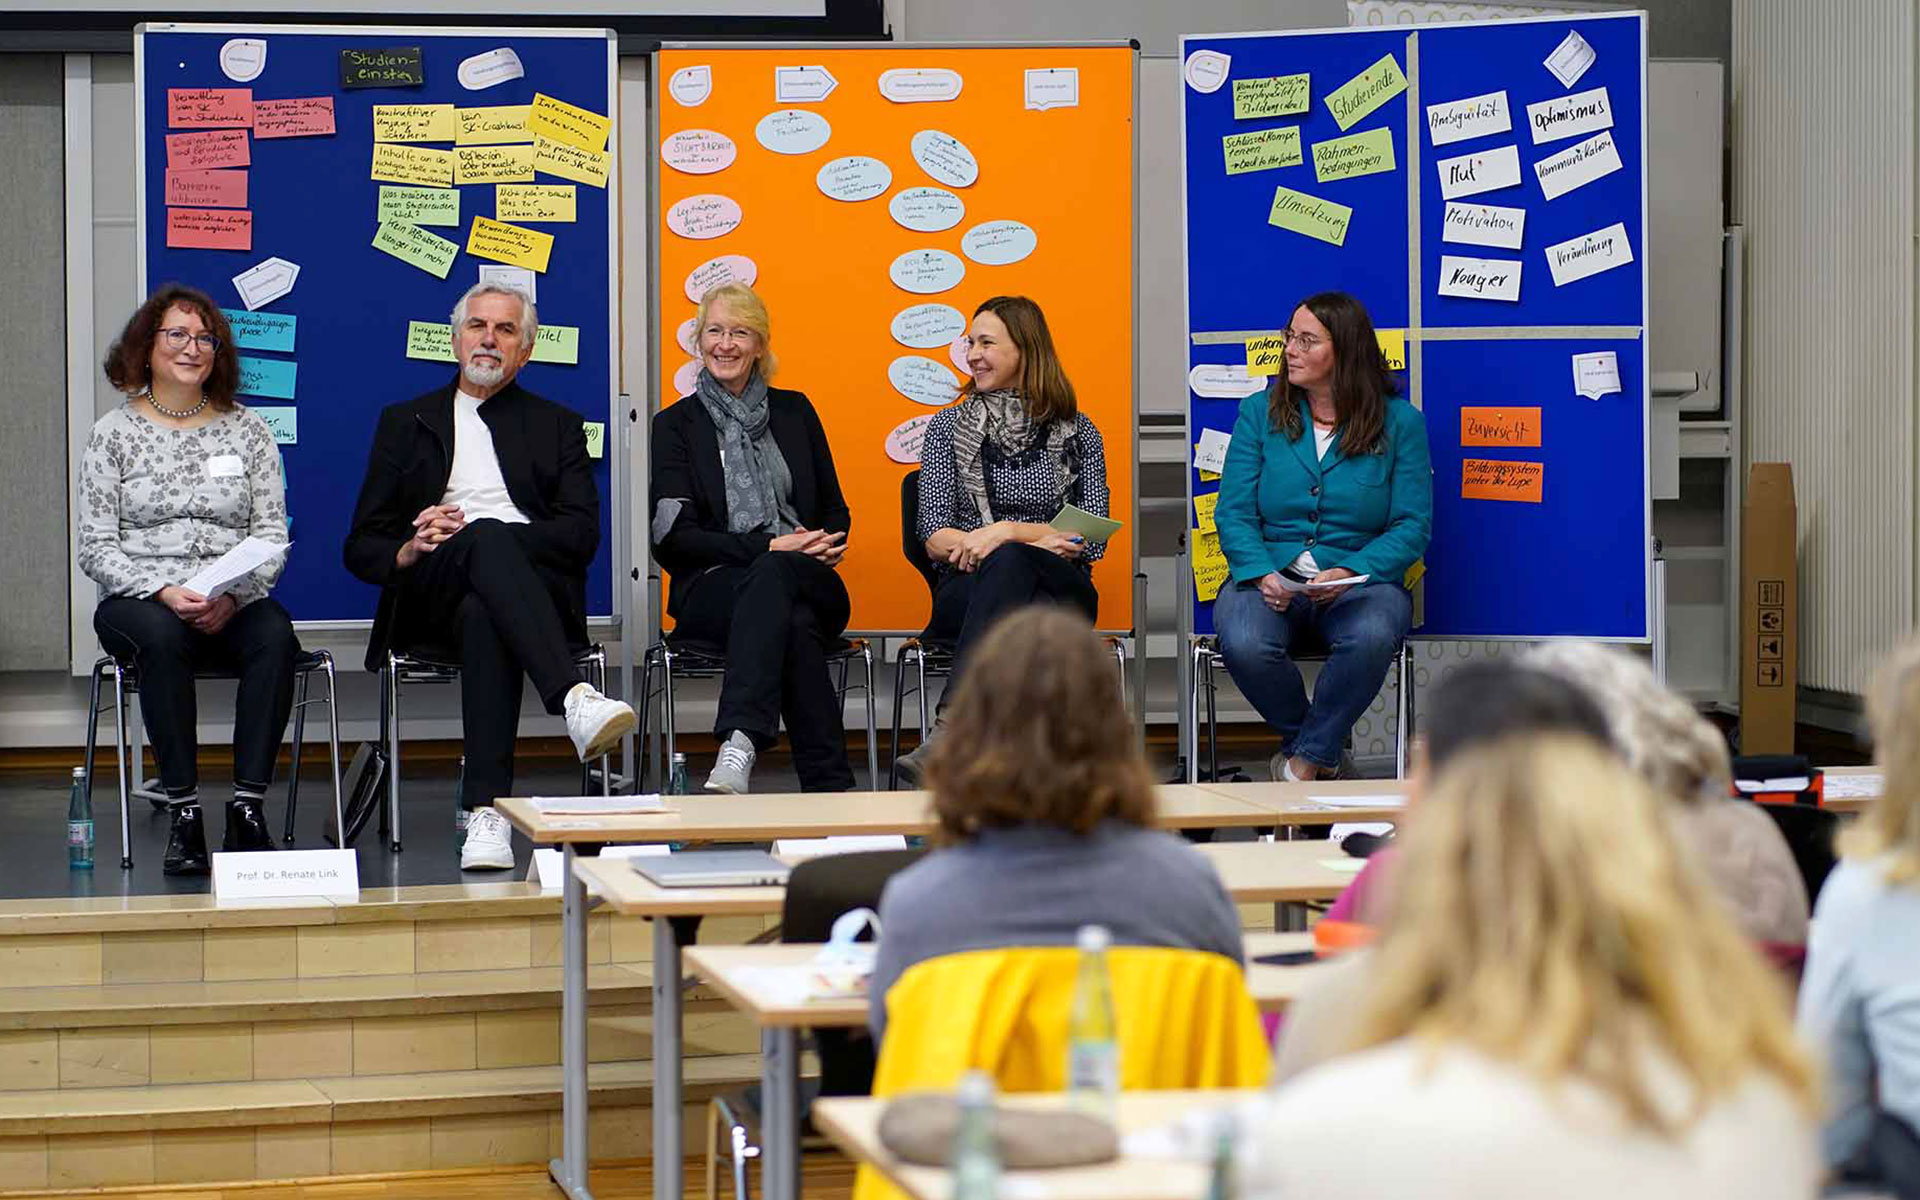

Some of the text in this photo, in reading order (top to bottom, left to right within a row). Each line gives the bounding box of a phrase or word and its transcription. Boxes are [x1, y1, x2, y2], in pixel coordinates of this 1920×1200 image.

[351, 51, 418, 67] Studien-
[1333, 68, 1395, 121] Studierende
[1430, 99, 1500, 130] Ambiguität
[1535, 100, 1605, 132] Optimismus
[380, 146, 416, 162] Inhalte
[1258, 157, 1268, 167] to
[1316, 143, 1371, 162] Rahmen-
[1539, 140, 1611, 178] Kommunikation
[1319, 154, 1382, 176] bedingungen
[1450, 158, 1476, 185] Mut
[1446, 207, 1514, 231] Motivation
[1467, 417, 1531, 442] Zuversicht
[1465, 461, 1541, 477] Bildungssystem
[1507, 476, 1533, 490] Lupe
[237, 869, 339, 880] Prof. Dr. Renate Link
